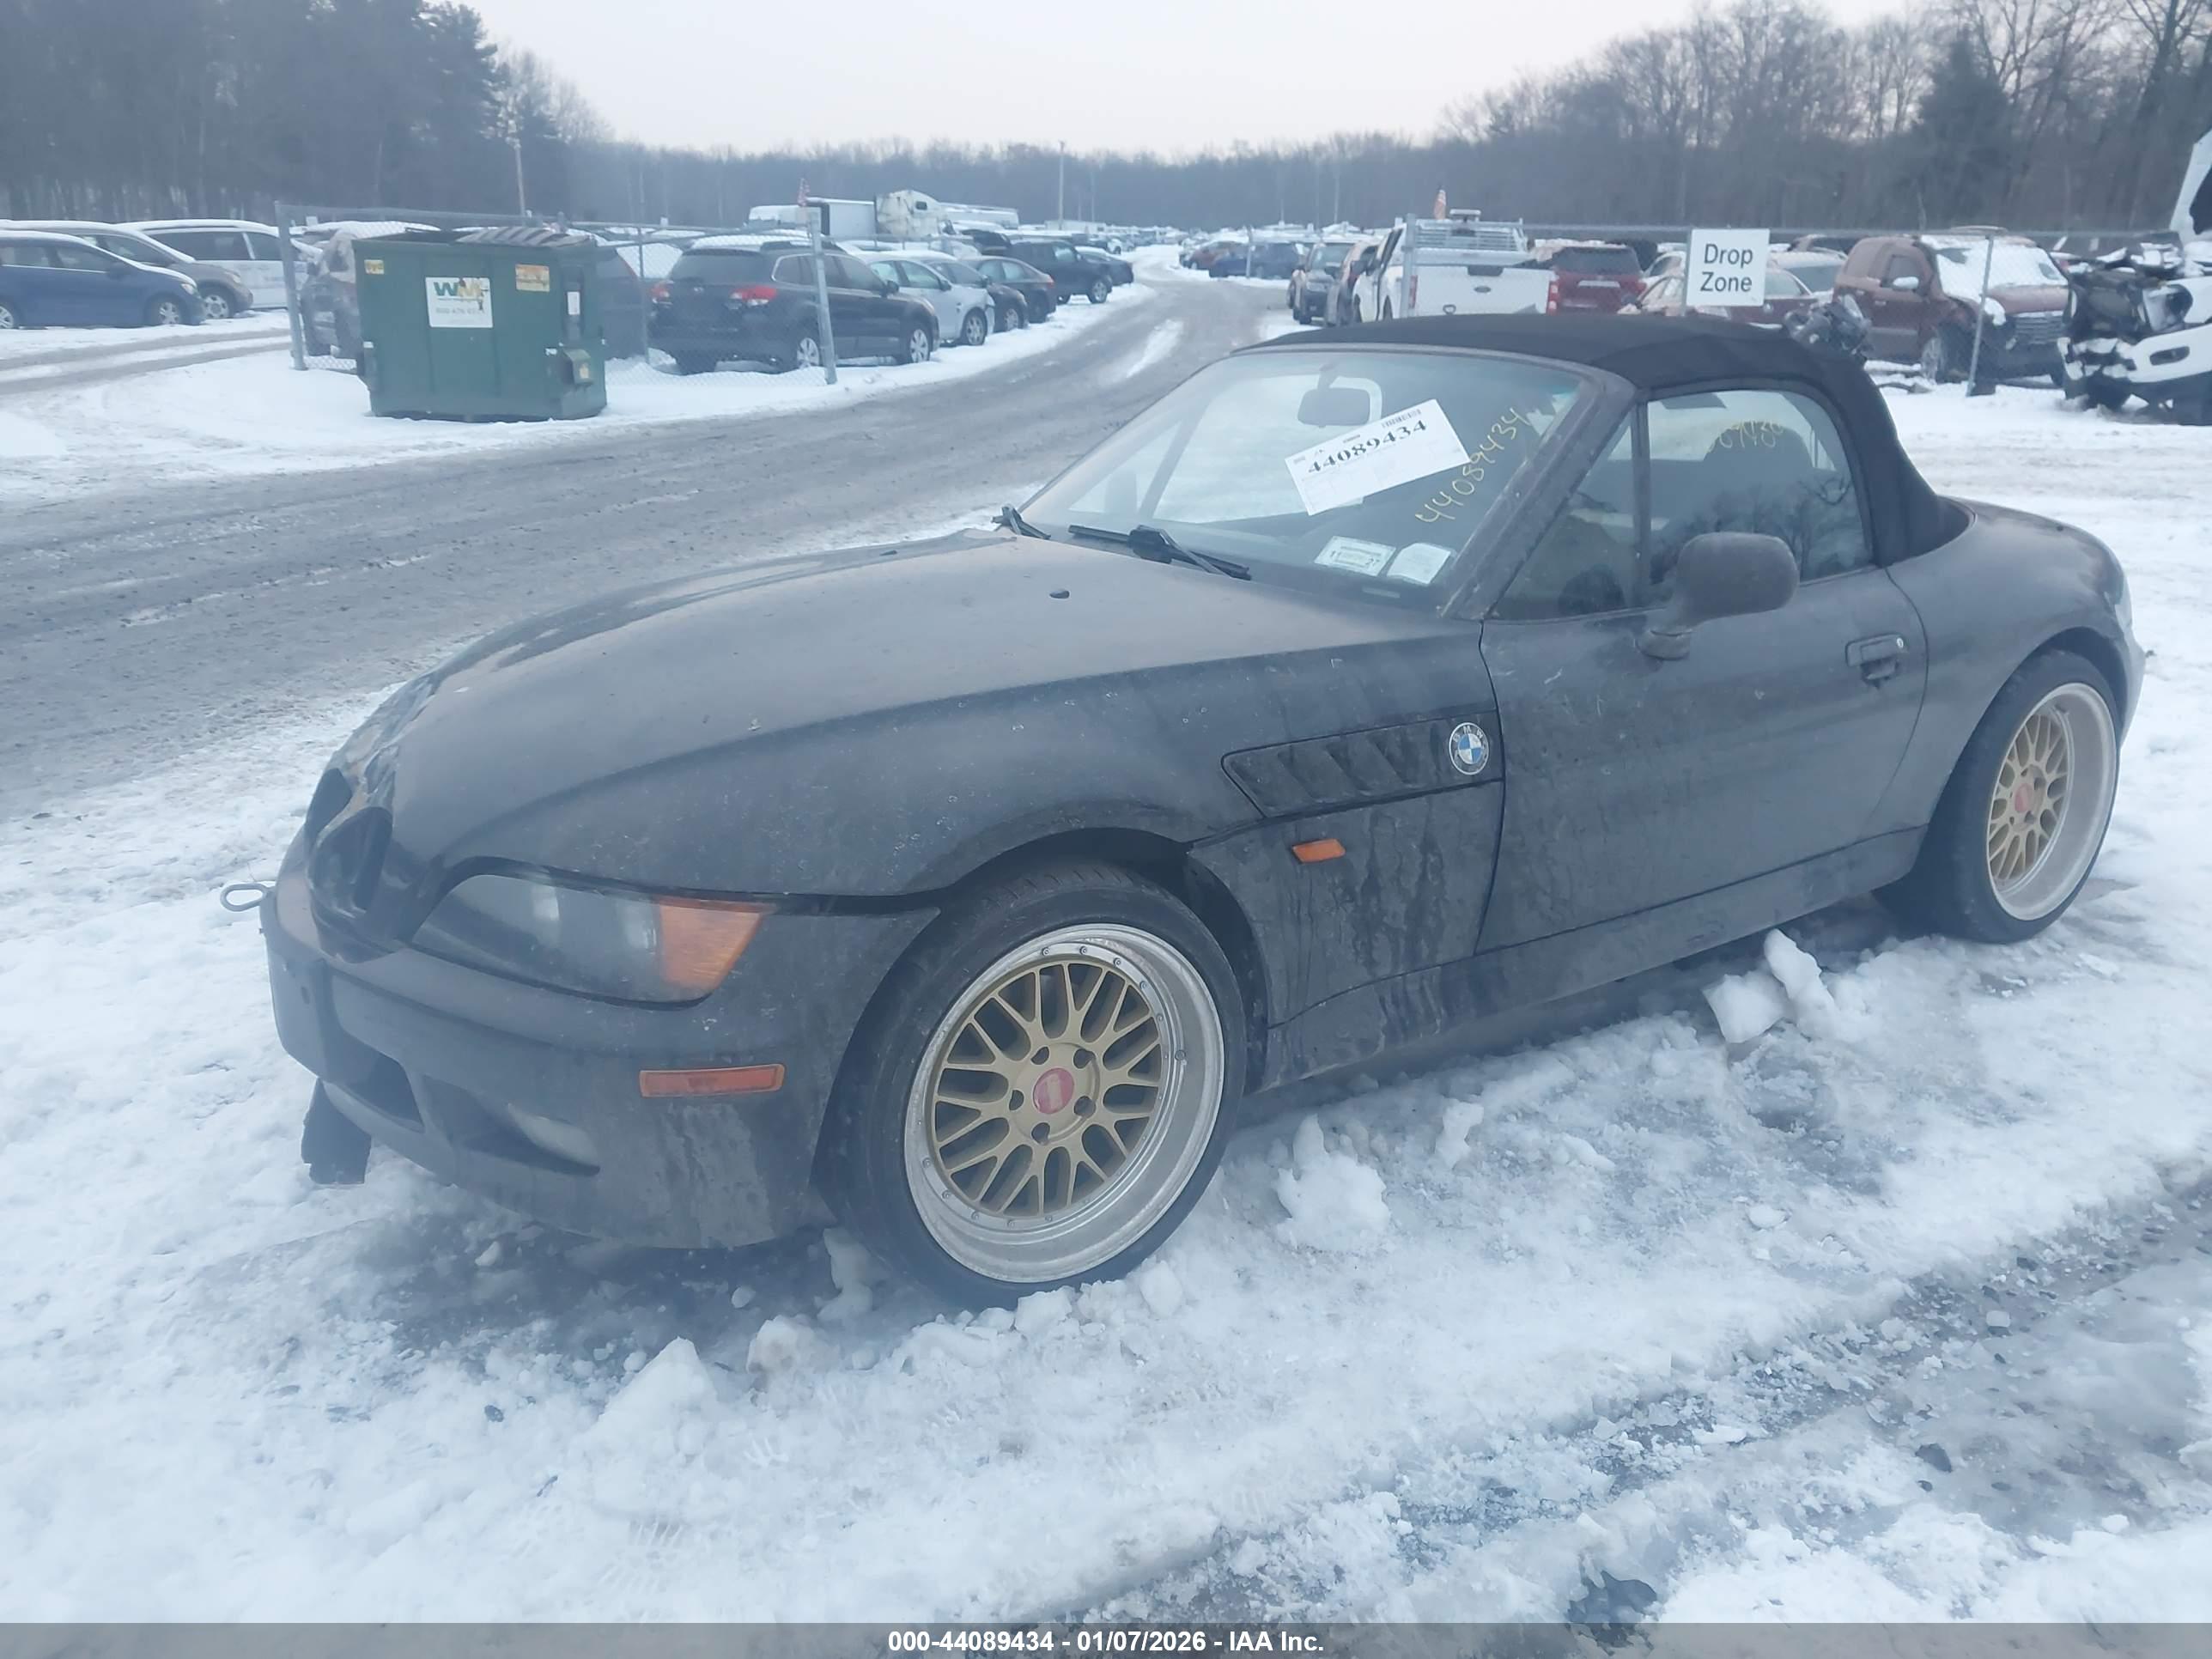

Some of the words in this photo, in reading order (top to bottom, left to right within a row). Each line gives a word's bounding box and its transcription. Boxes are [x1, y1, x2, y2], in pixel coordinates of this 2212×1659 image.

[1704, 243, 1753, 269] Drop
[1700, 271, 1753, 292] Zone
[1308, 419, 1427, 473] 44089434
[1414, 407, 1531, 523] 44089434
[1452, 725, 1484, 743] BMW
